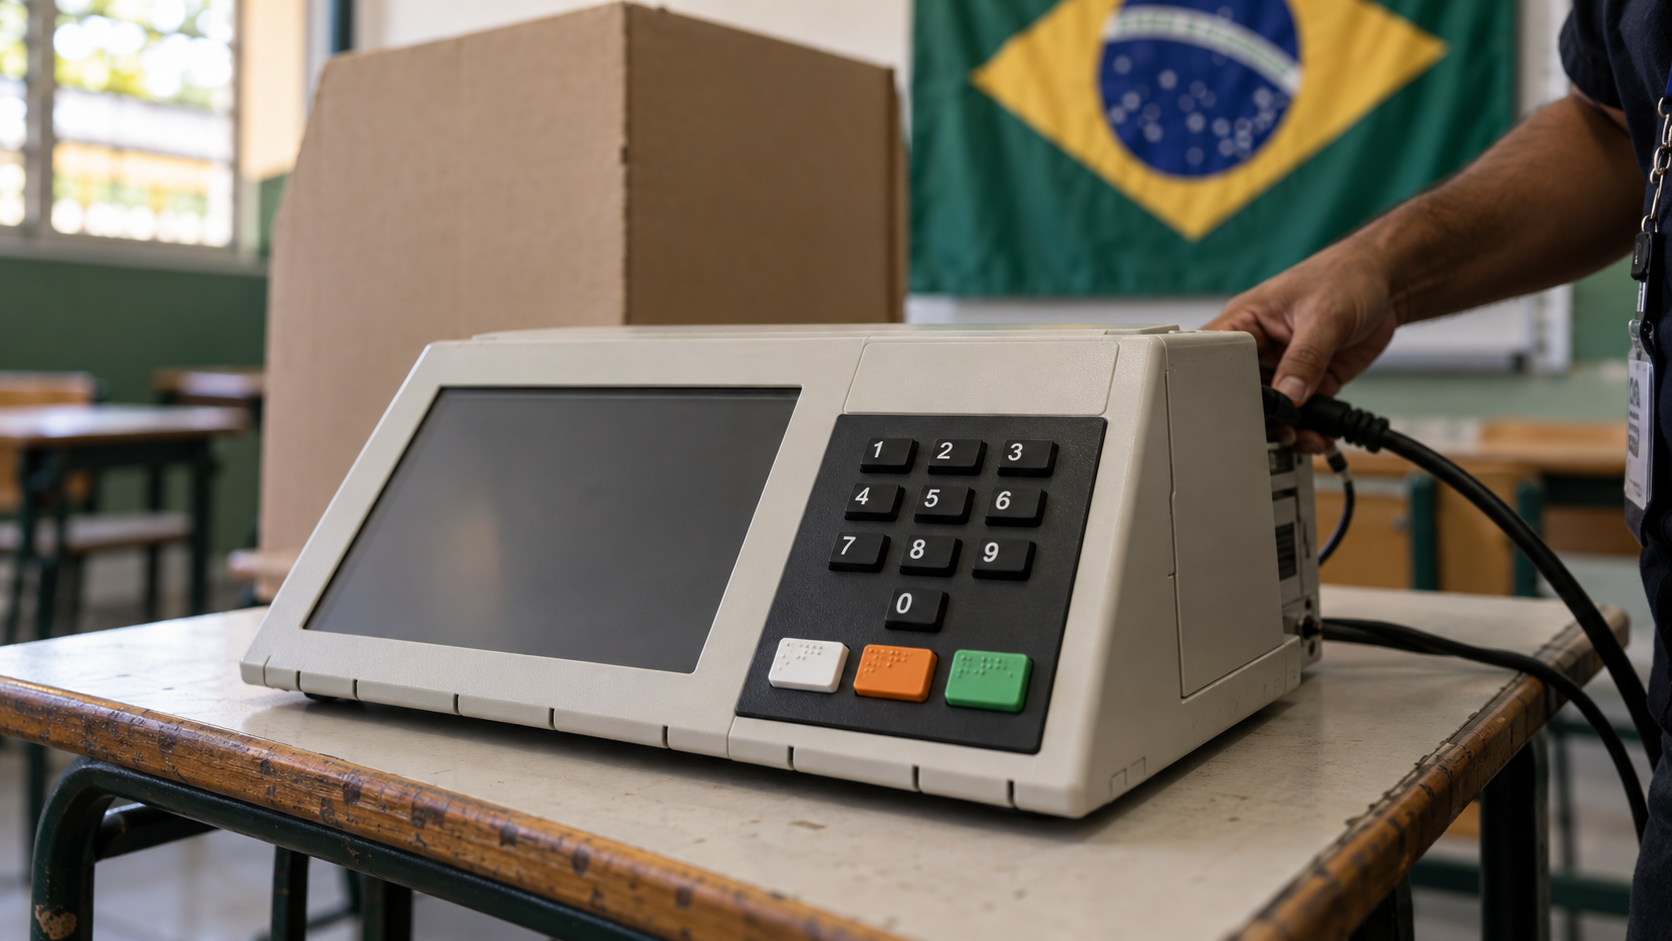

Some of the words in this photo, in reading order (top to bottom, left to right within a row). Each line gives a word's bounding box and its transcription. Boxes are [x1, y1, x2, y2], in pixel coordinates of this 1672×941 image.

[873, 440, 884, 459] 1
[936, 441, 954, 460] 2
[1007, 442, 1024, 462] 3
[854, 486, 870, 505] 4
[923, 488, 941, 508] 5
[995, 490, 1012, 510] 6
[840, 535, 857, 556] 7
[909, 538, 926, 560] 8
[982, 541, 999, 563] 9
[896, 592, 913, 614] 0
